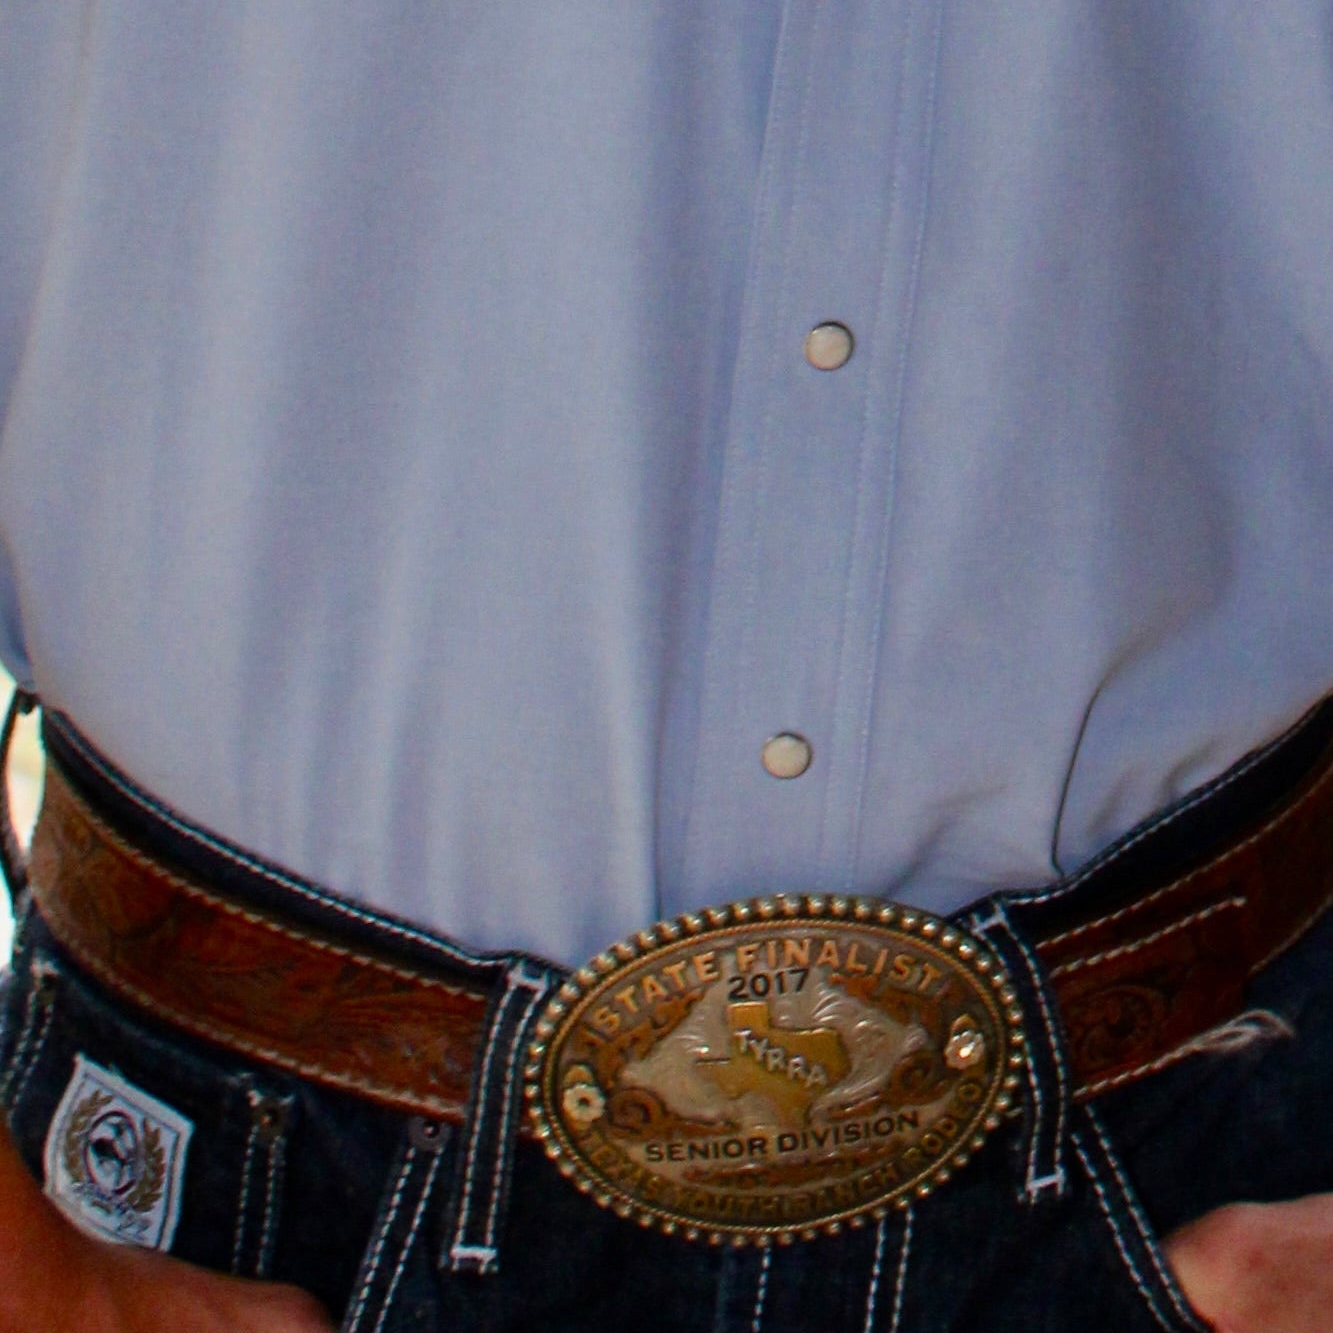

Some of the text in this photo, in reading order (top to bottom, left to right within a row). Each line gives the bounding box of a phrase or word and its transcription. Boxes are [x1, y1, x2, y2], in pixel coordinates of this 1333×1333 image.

[592, 938, 942, 1033] STATE FINALIST
[728, 968, 809, 1000] 2017
[733, 1029, 828, 1088] TYRRA
[645, 1109, 920, 1163] SENIOR DIVISION
